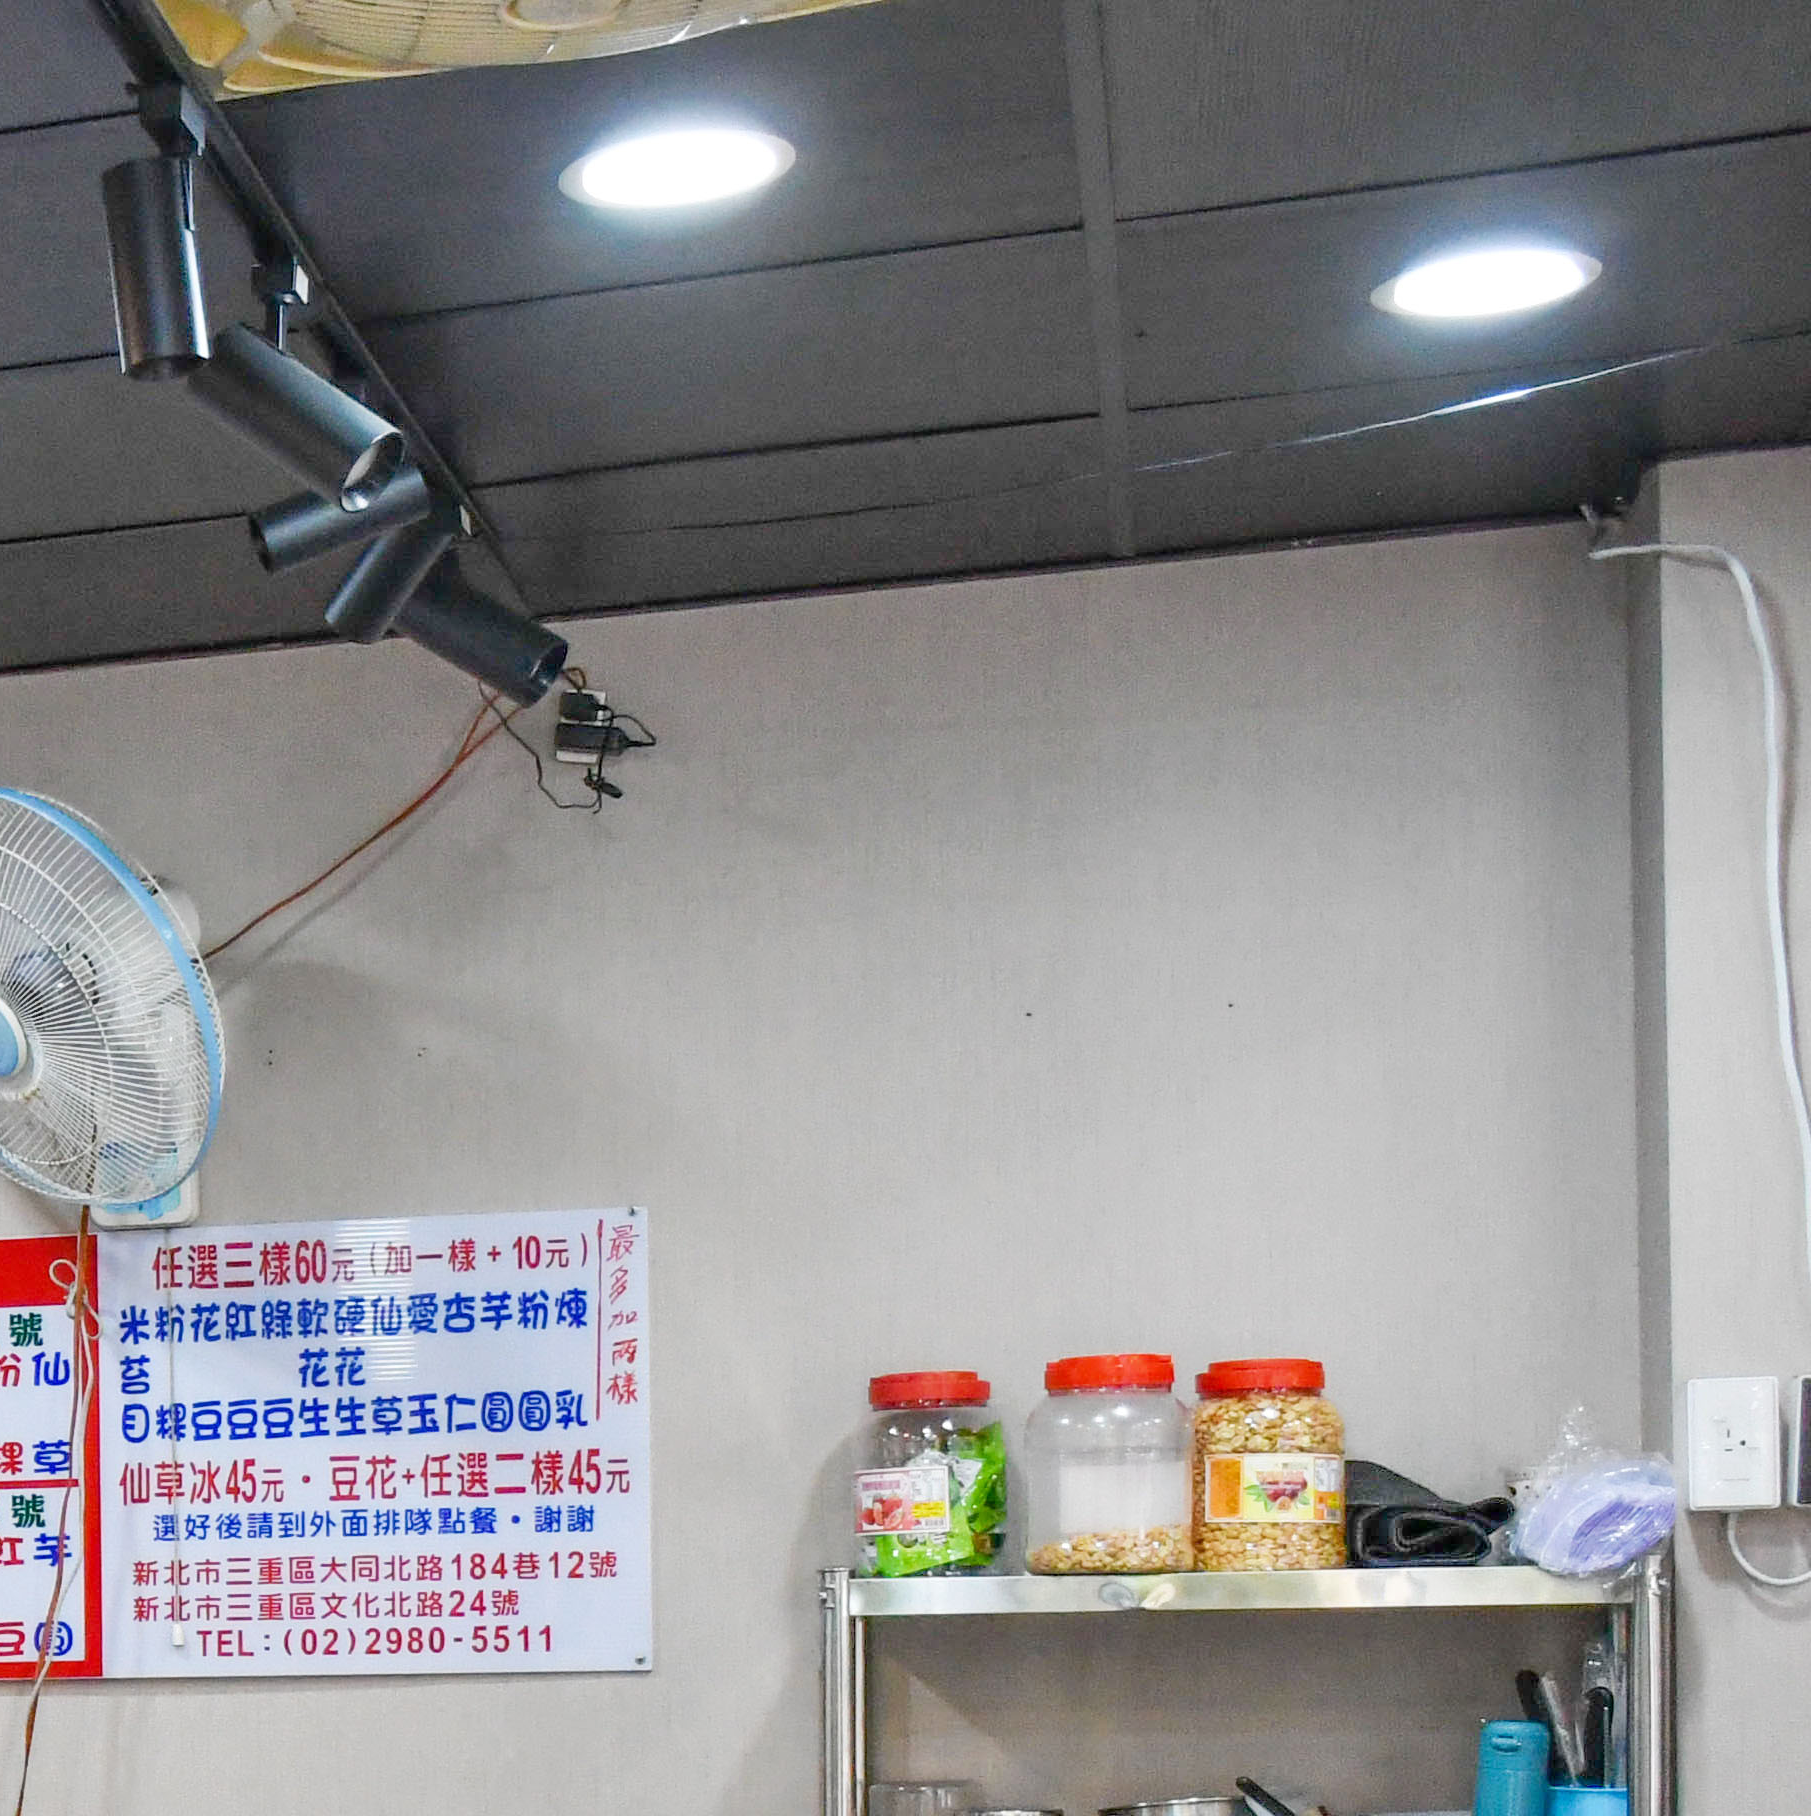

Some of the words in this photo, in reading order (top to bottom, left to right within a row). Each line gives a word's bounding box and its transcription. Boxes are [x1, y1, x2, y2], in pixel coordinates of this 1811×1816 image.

[133, 1550, 618, 1586] 新北市三重區大同北路184巷12號
[134, 1588, 520, 1622] 新北市三重區文化北路24號
